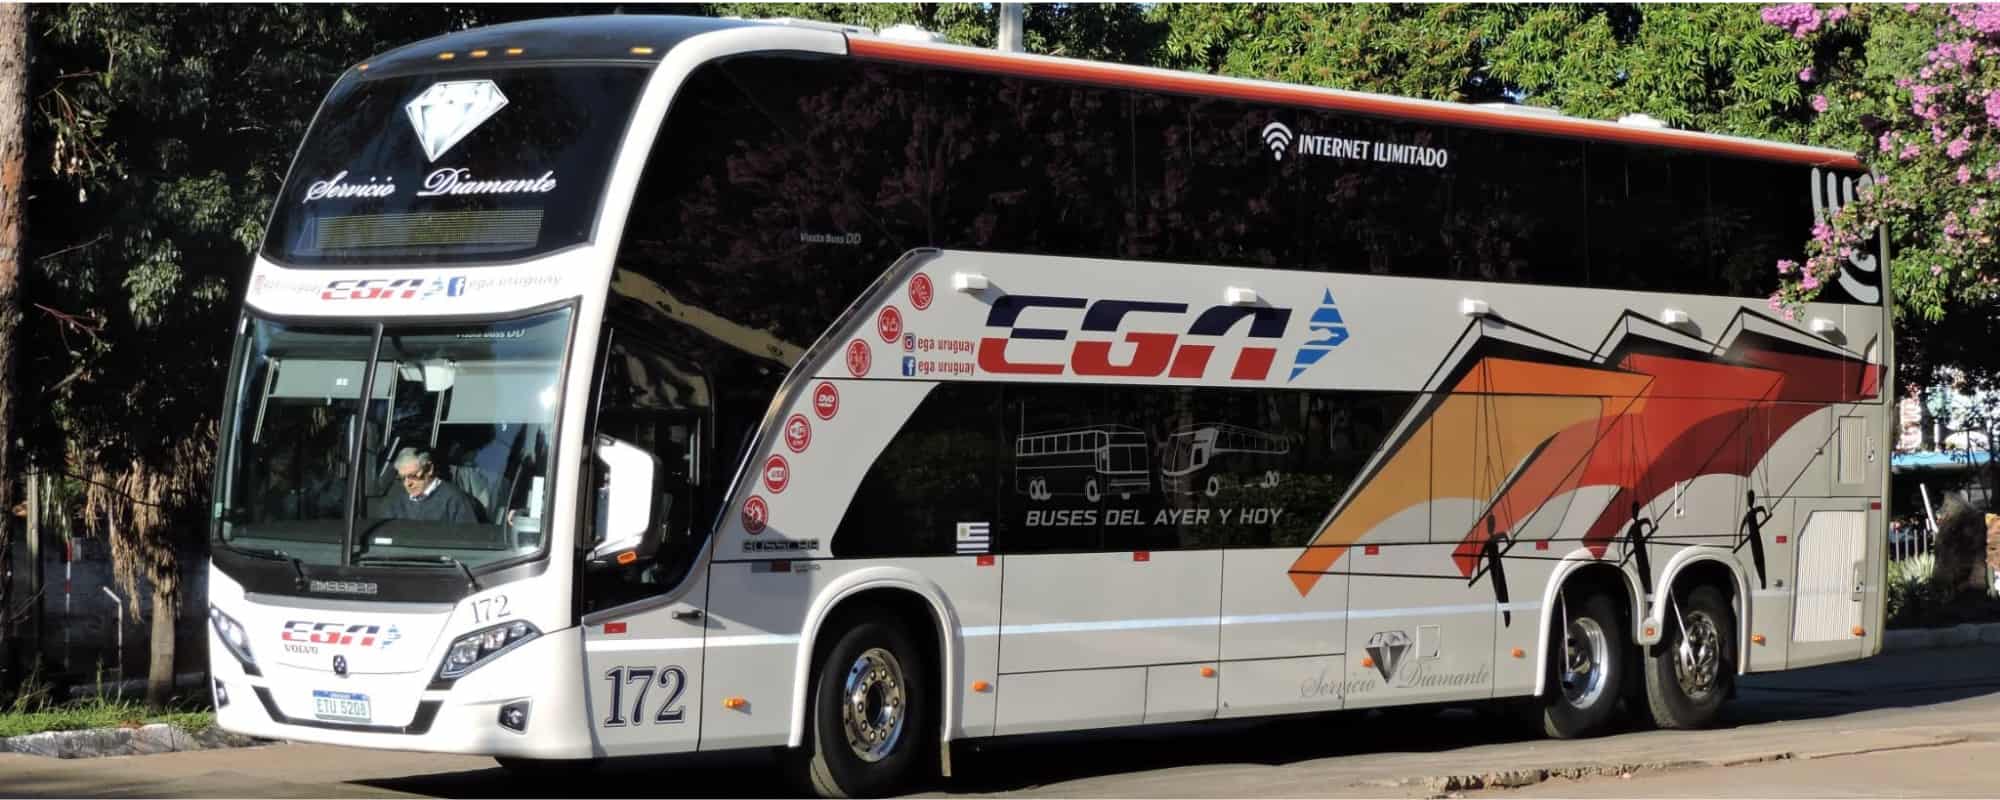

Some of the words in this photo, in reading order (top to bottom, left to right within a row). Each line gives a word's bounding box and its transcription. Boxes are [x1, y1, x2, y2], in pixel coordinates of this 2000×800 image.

[1299, 134, 1370, 161] INTERNET
[1373, 142, 1448, 168] ILIMITADO
[303, 170, 396, 203] Servicio
[416, 167, 557, 197] Diamante
[321, 278, 424, 301] EGA
[918, 339, 935, 352] ega
[938, 338, 976, 355] uruguay
[977, 294, 1292, 381] EGA
[918, 361, 935, 374] ega
[938, 360, 976, 377] uruguay
[1025, 509, 1097, 527] BUSES
[1105, 509, 1145, 526] DEL
[1153, 508, 1210, 526] AYER
[1219, 508, 1233, 525] Y
[1239, 507, 1283, 525] HOY
[472, 594, 512, 625] 172
[282, 620, 380, 647] EGA
[1300, 670, 1376, 697] Servicio
[1393, 663, 1490, 689] Diamante
[604, 664, 688, 728] 172
